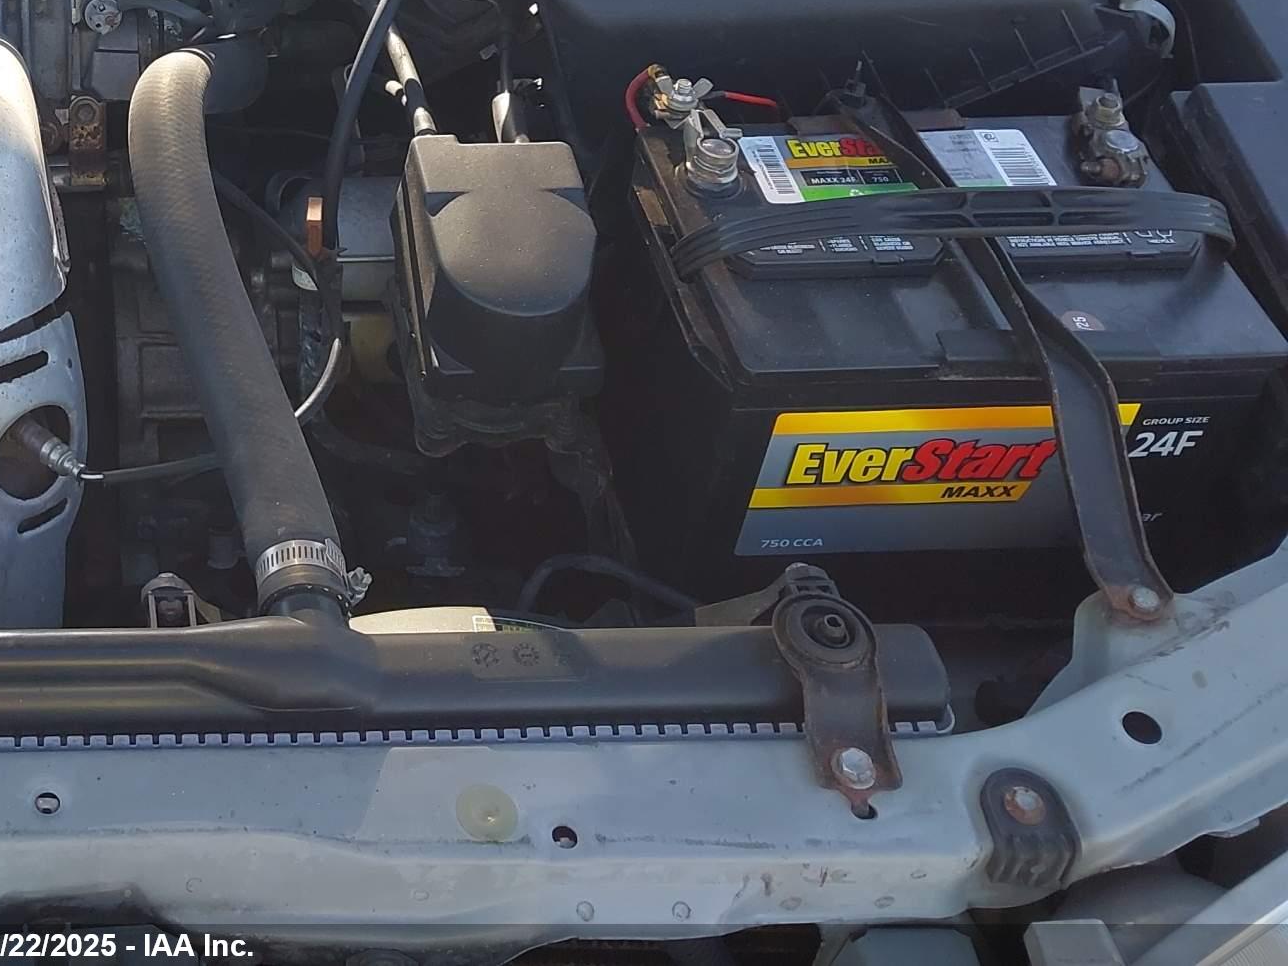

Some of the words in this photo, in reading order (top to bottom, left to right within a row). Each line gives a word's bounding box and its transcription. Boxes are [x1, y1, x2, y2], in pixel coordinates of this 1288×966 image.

[786, 137, 884, 158] EverSta
[1142, 417, 1184, 426] GROUP
[1184, 416, 1211, 424] SIZE
[1127, 430, 1204, 458] 24F
[785, 437, 1057, 485] EverStart
[940, 485, 1017, 500] MAXX
[761, 538, 790, 548] 750
[793, 537, 824, 548] CCA
